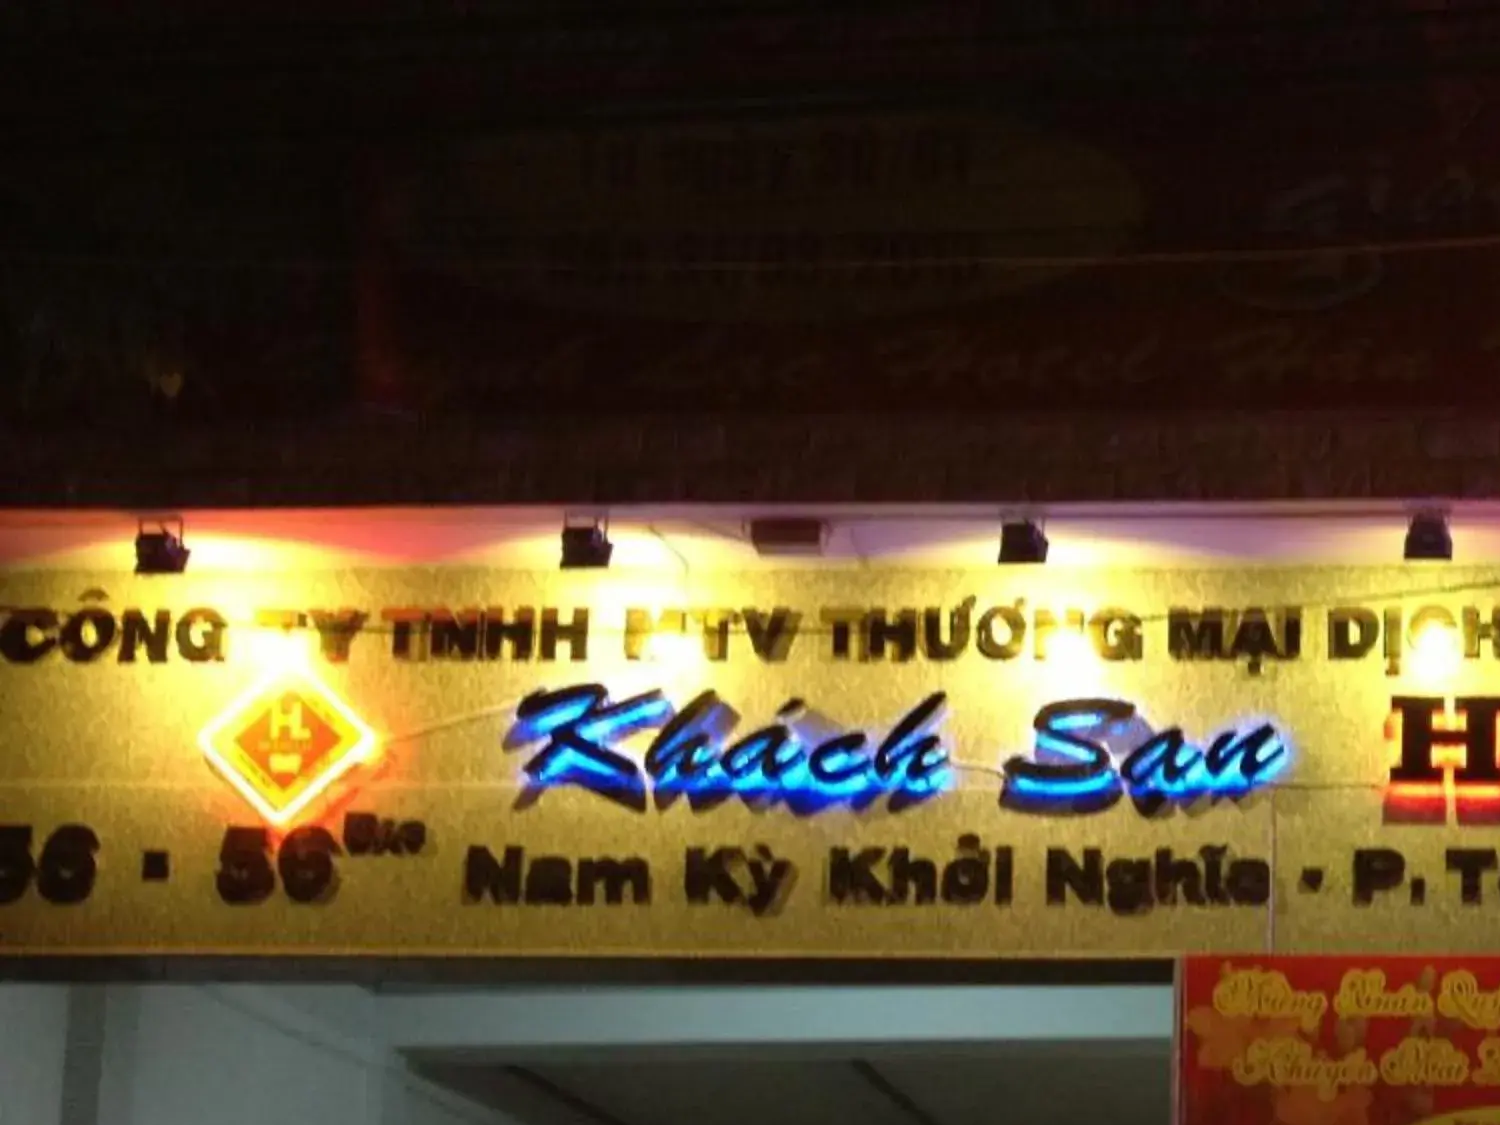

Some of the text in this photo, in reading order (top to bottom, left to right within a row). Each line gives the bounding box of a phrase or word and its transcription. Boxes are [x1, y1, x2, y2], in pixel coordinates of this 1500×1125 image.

[0, 589, 228, 664] CÔNG
[382, 604, 590, 663] TNHH
[1168, 605, 1301, 676] MẠI
[503, 683, 1288, 806] Khách San
[464, 845, 652, 906] Nam
[684, 842, 799, 917] Kỳ
